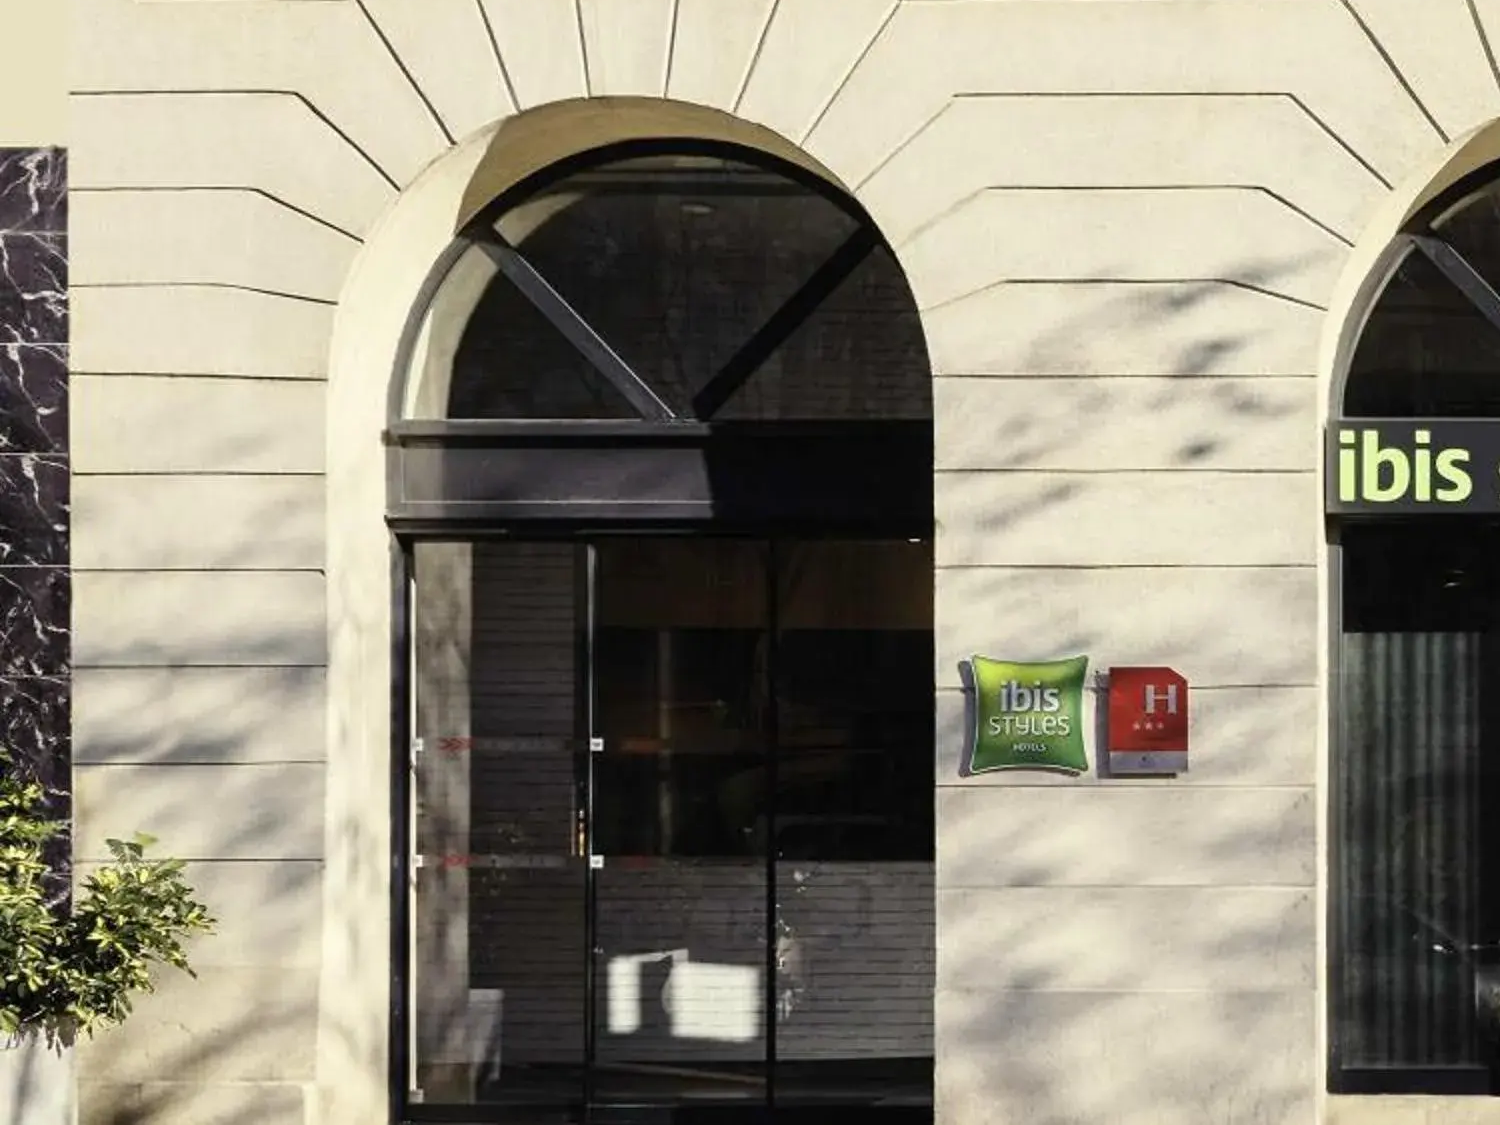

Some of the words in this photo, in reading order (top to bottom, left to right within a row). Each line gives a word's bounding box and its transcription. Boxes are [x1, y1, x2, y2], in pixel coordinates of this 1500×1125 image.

[1339, 430, 1473, 502] ibis
[1001, 680, 1059, 712] ibis
[1145, 684, 1177, 714] H
